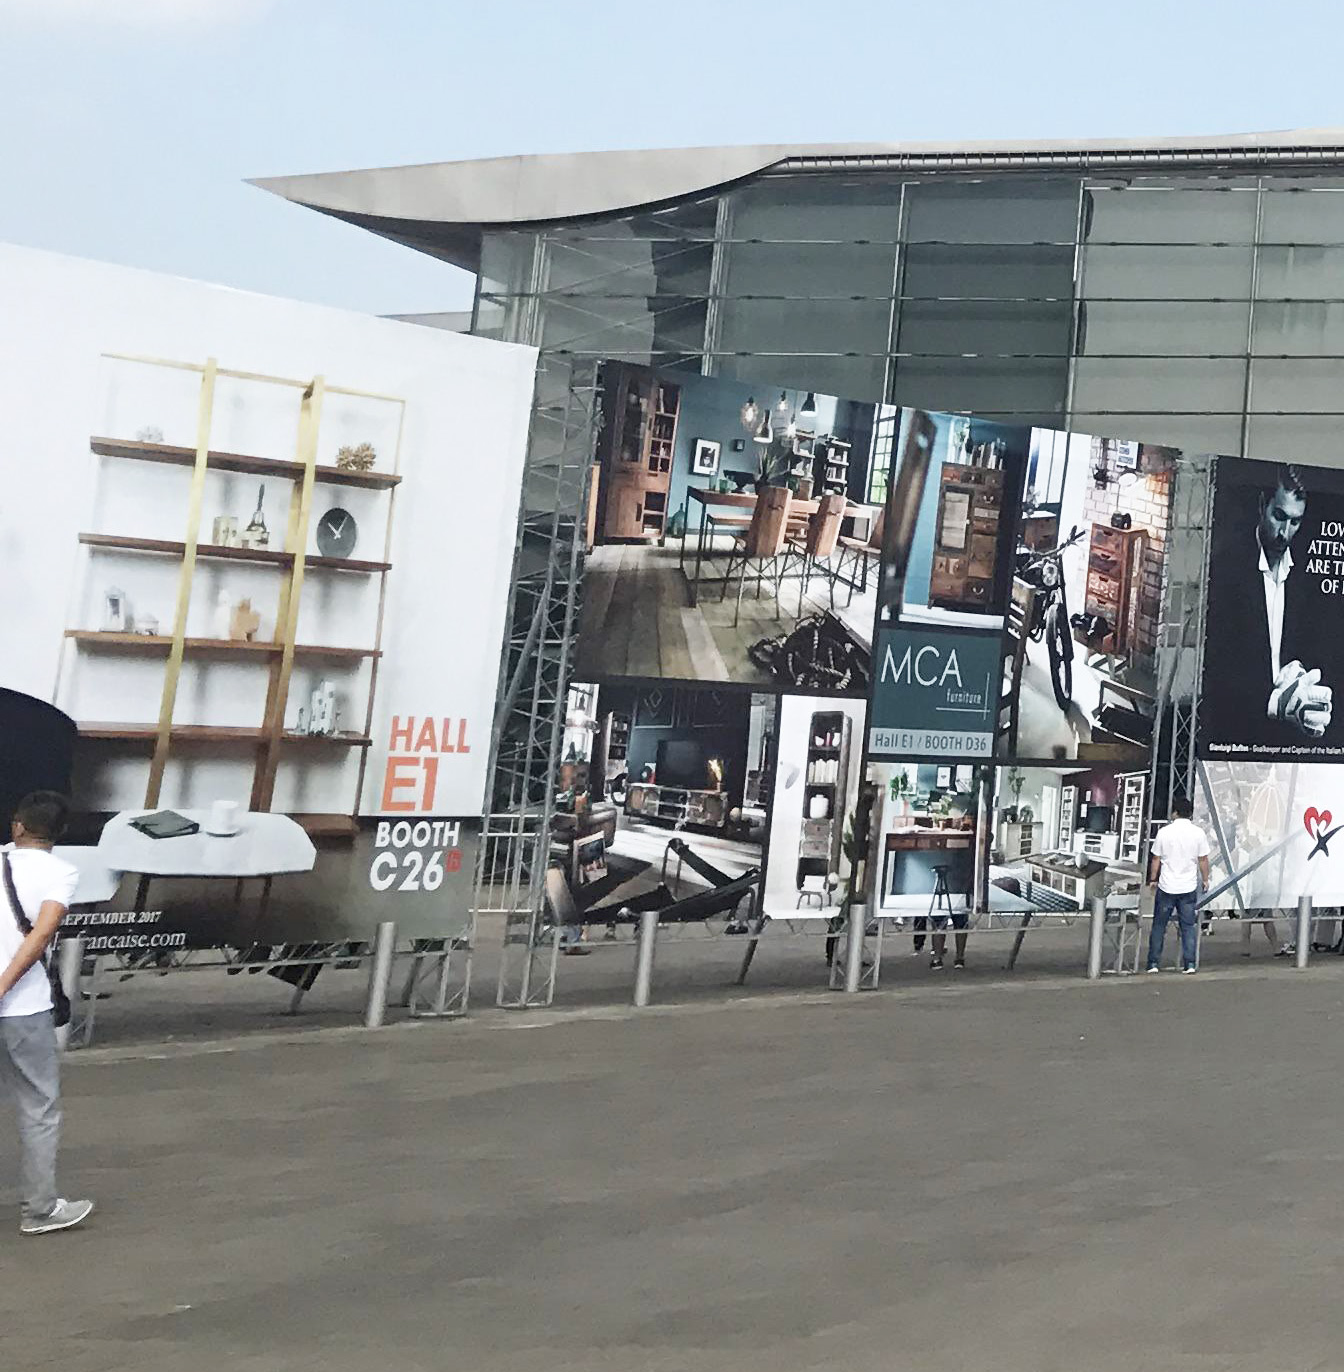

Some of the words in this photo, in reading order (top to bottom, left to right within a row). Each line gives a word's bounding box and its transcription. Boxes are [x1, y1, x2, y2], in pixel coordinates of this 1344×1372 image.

[1306, 559, 1330, 575] ARE
[1321, 579, 1340, 594] OF
[880, 644, 962, 688] MCA
[946, 688, 982, 705] furniture
[389, 715, 471, 753] HALL
[875, 733, 898, 748] Hall
[901, 734, 913, 748] E1
[925, 735, 962, 750] BOOTH
[966, 736, 987, 751] D36
[381, 756, 439, 812] E1
[375, 820, 461, 848] BOOTH
[369, 850, 444, 892] C26
[137, 911, 162, 924] 2017
